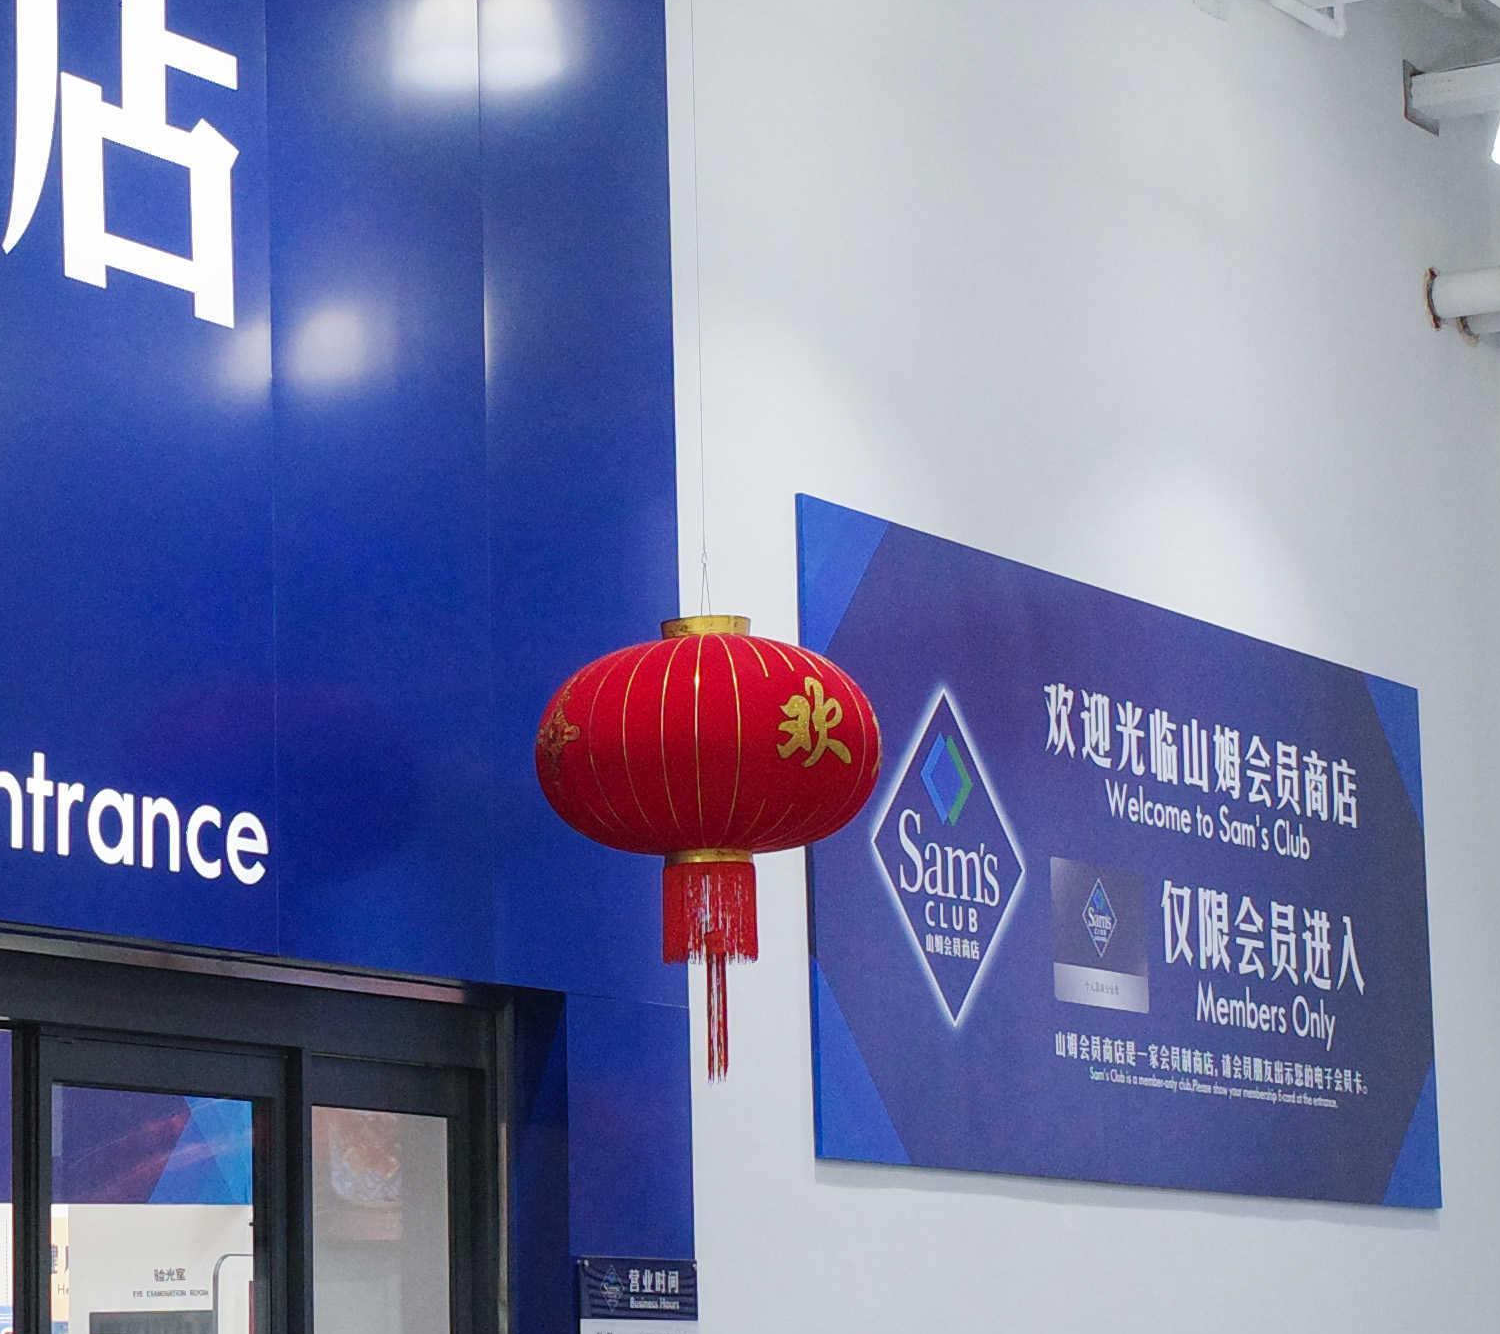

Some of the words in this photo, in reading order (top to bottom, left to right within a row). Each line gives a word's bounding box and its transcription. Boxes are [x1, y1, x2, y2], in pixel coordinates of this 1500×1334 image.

[776, 676, 852, 767] 欢
[1043, 681, 1359, 829] 欢迎光临山姆会员商店
[898, 809, 1001, 908] Sam's
[1105, 778, 1192, 834] Welcome
[1196, 805, 1214, 840] to
[1219, 804, 1269, 852] Sam's
[1273, 818, 1311, 861] Club
[925, 900, 979, 933] CLUB
[925, 933, 981, 961] 山姆会员商店
[1160, 879, 1367, 997] 仅限会员进入
[1196, 980, 1288, 1035] Members
[1291, 994, 1337, 1052] Only
[629, 1269, 680, 1295] 营业时间
